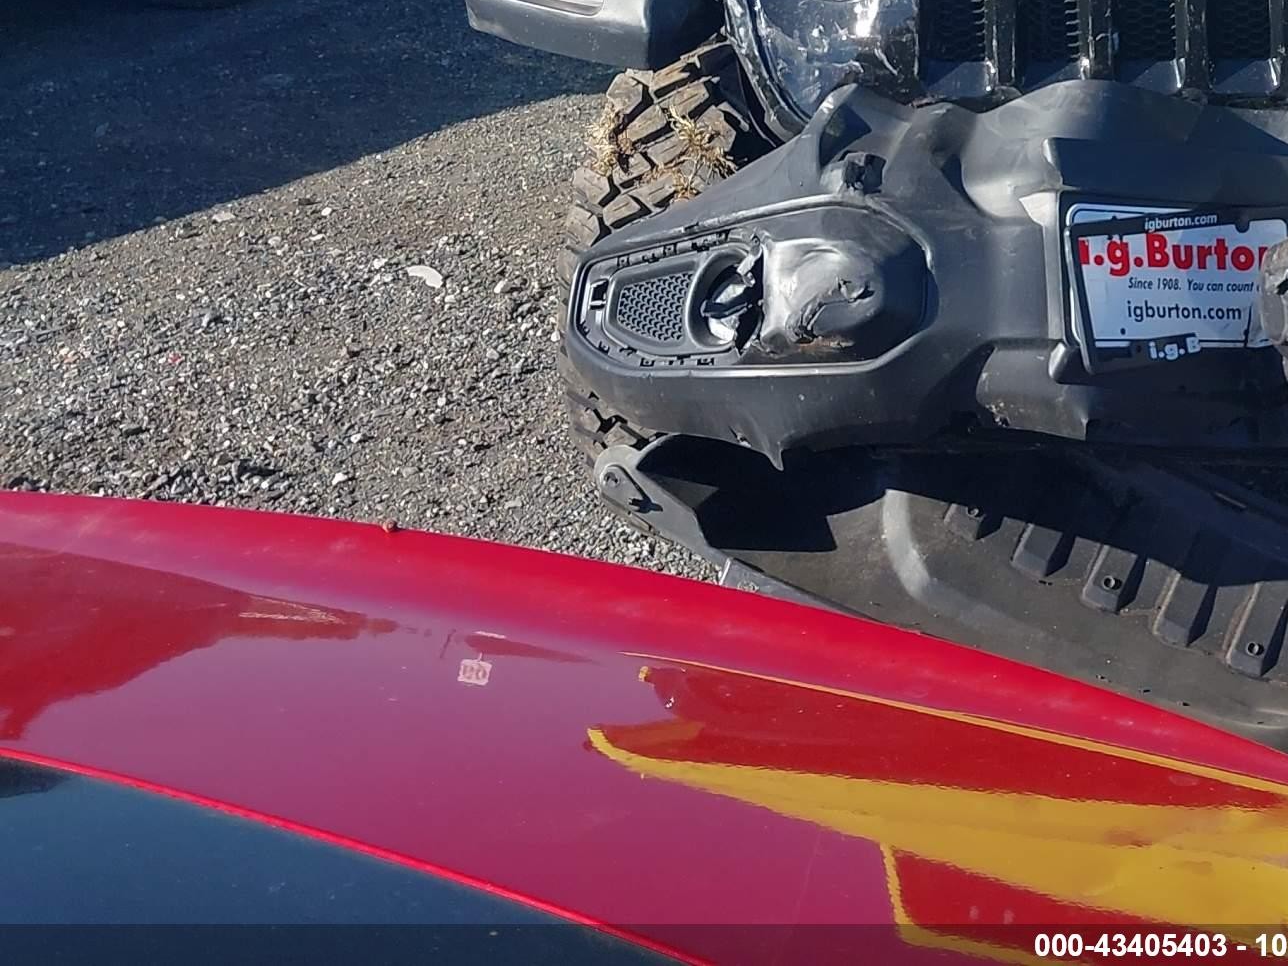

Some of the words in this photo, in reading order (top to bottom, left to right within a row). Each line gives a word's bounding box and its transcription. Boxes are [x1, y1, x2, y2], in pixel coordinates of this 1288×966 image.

[1144, 214, 1217, 232] igburton.com
[1127, 277, 1153, 290] Since
[1157, 278, 1182, 291] 1908.
[1187, 279, 1204, 291] You
[1206, 282, 1224, 292] can
[1226, 282, 1254, 292] count
[1127, 300, 1242, 323] igburton.com
